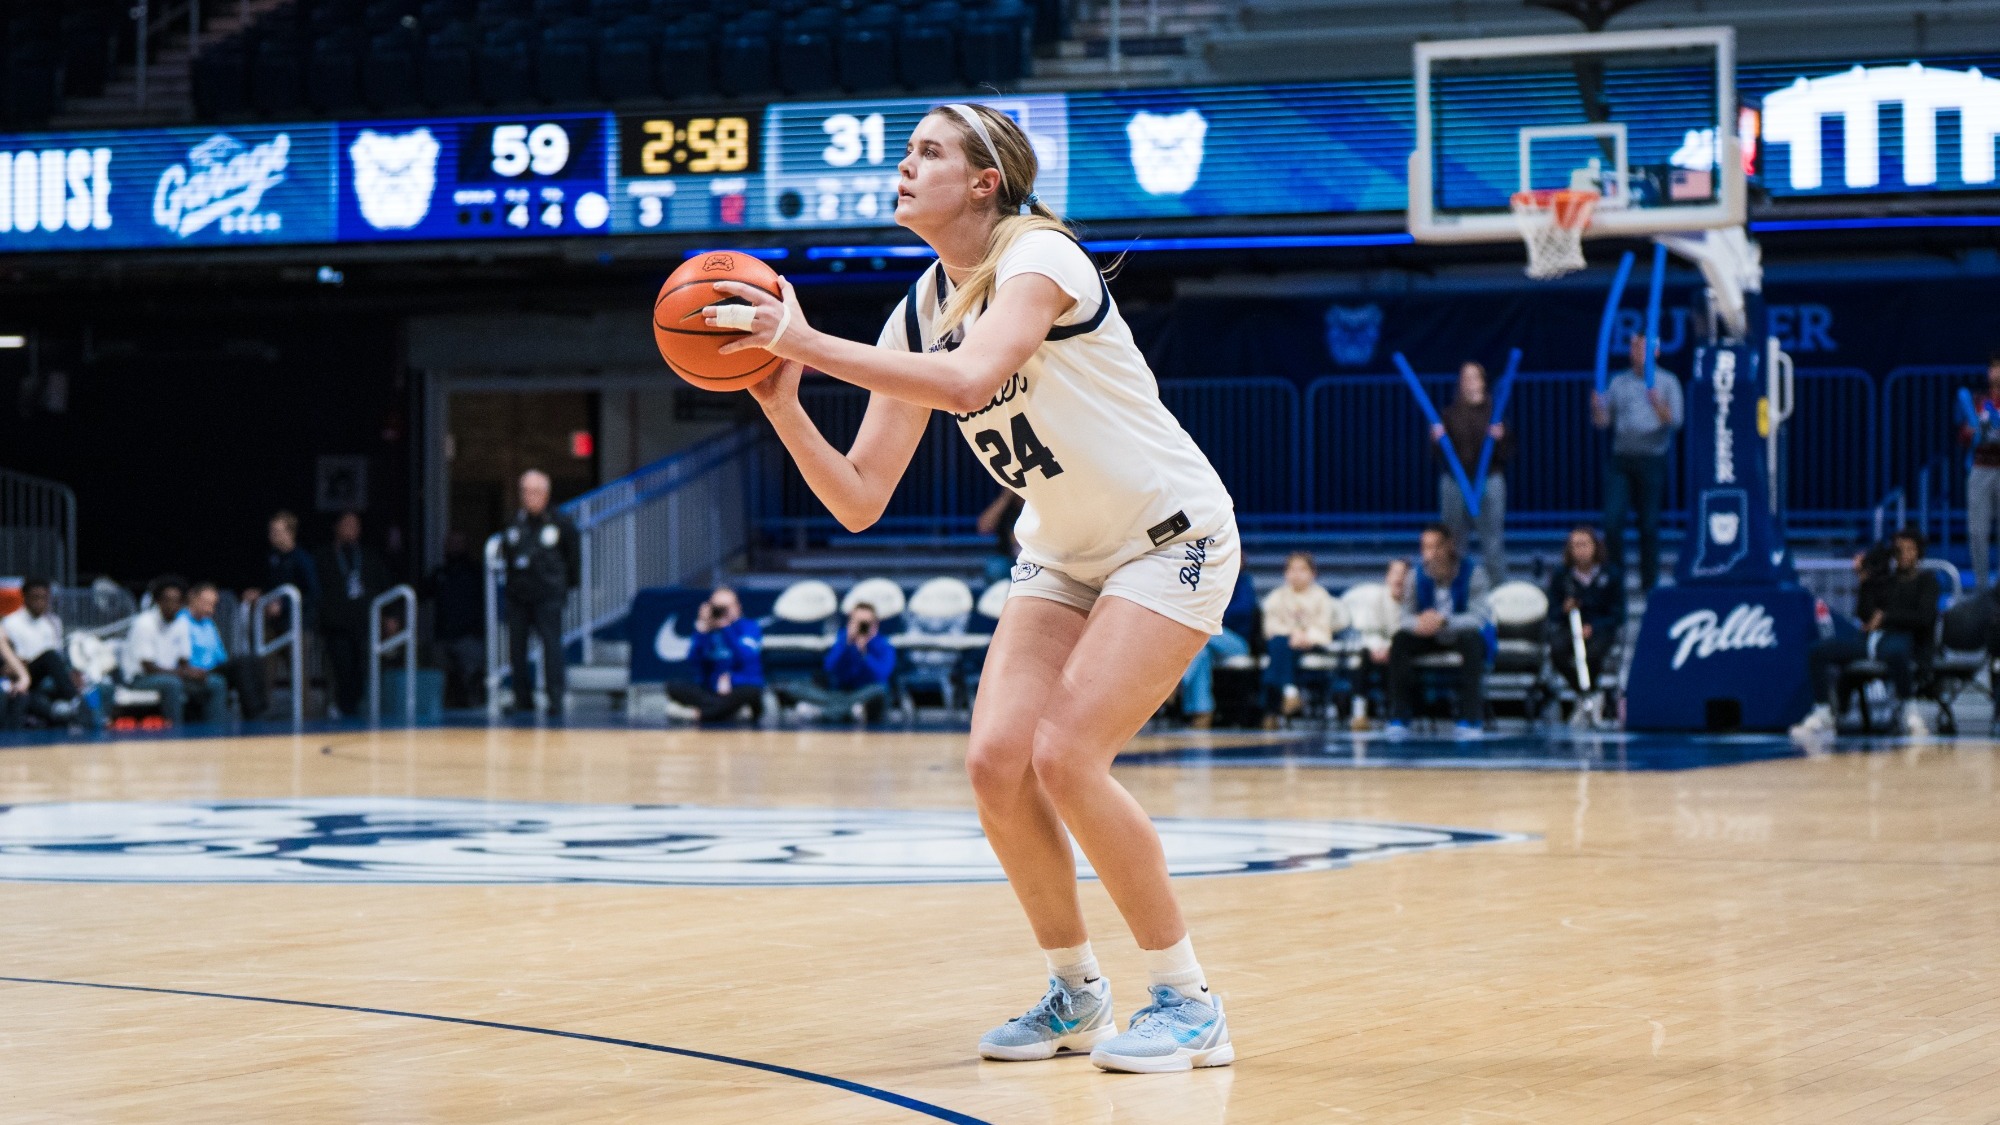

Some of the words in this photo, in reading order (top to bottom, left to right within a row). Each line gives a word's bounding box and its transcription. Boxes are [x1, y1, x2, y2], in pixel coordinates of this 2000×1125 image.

[491, 122, 570, 178] 59
[641, 116, 749, 175] 2:58
[822, 112, 886, 168] 31
[1609, 304, 1838, 355] BUER
[974, 411, 1065, 489] 24
[1667, 602, 1777, 671] Pella
